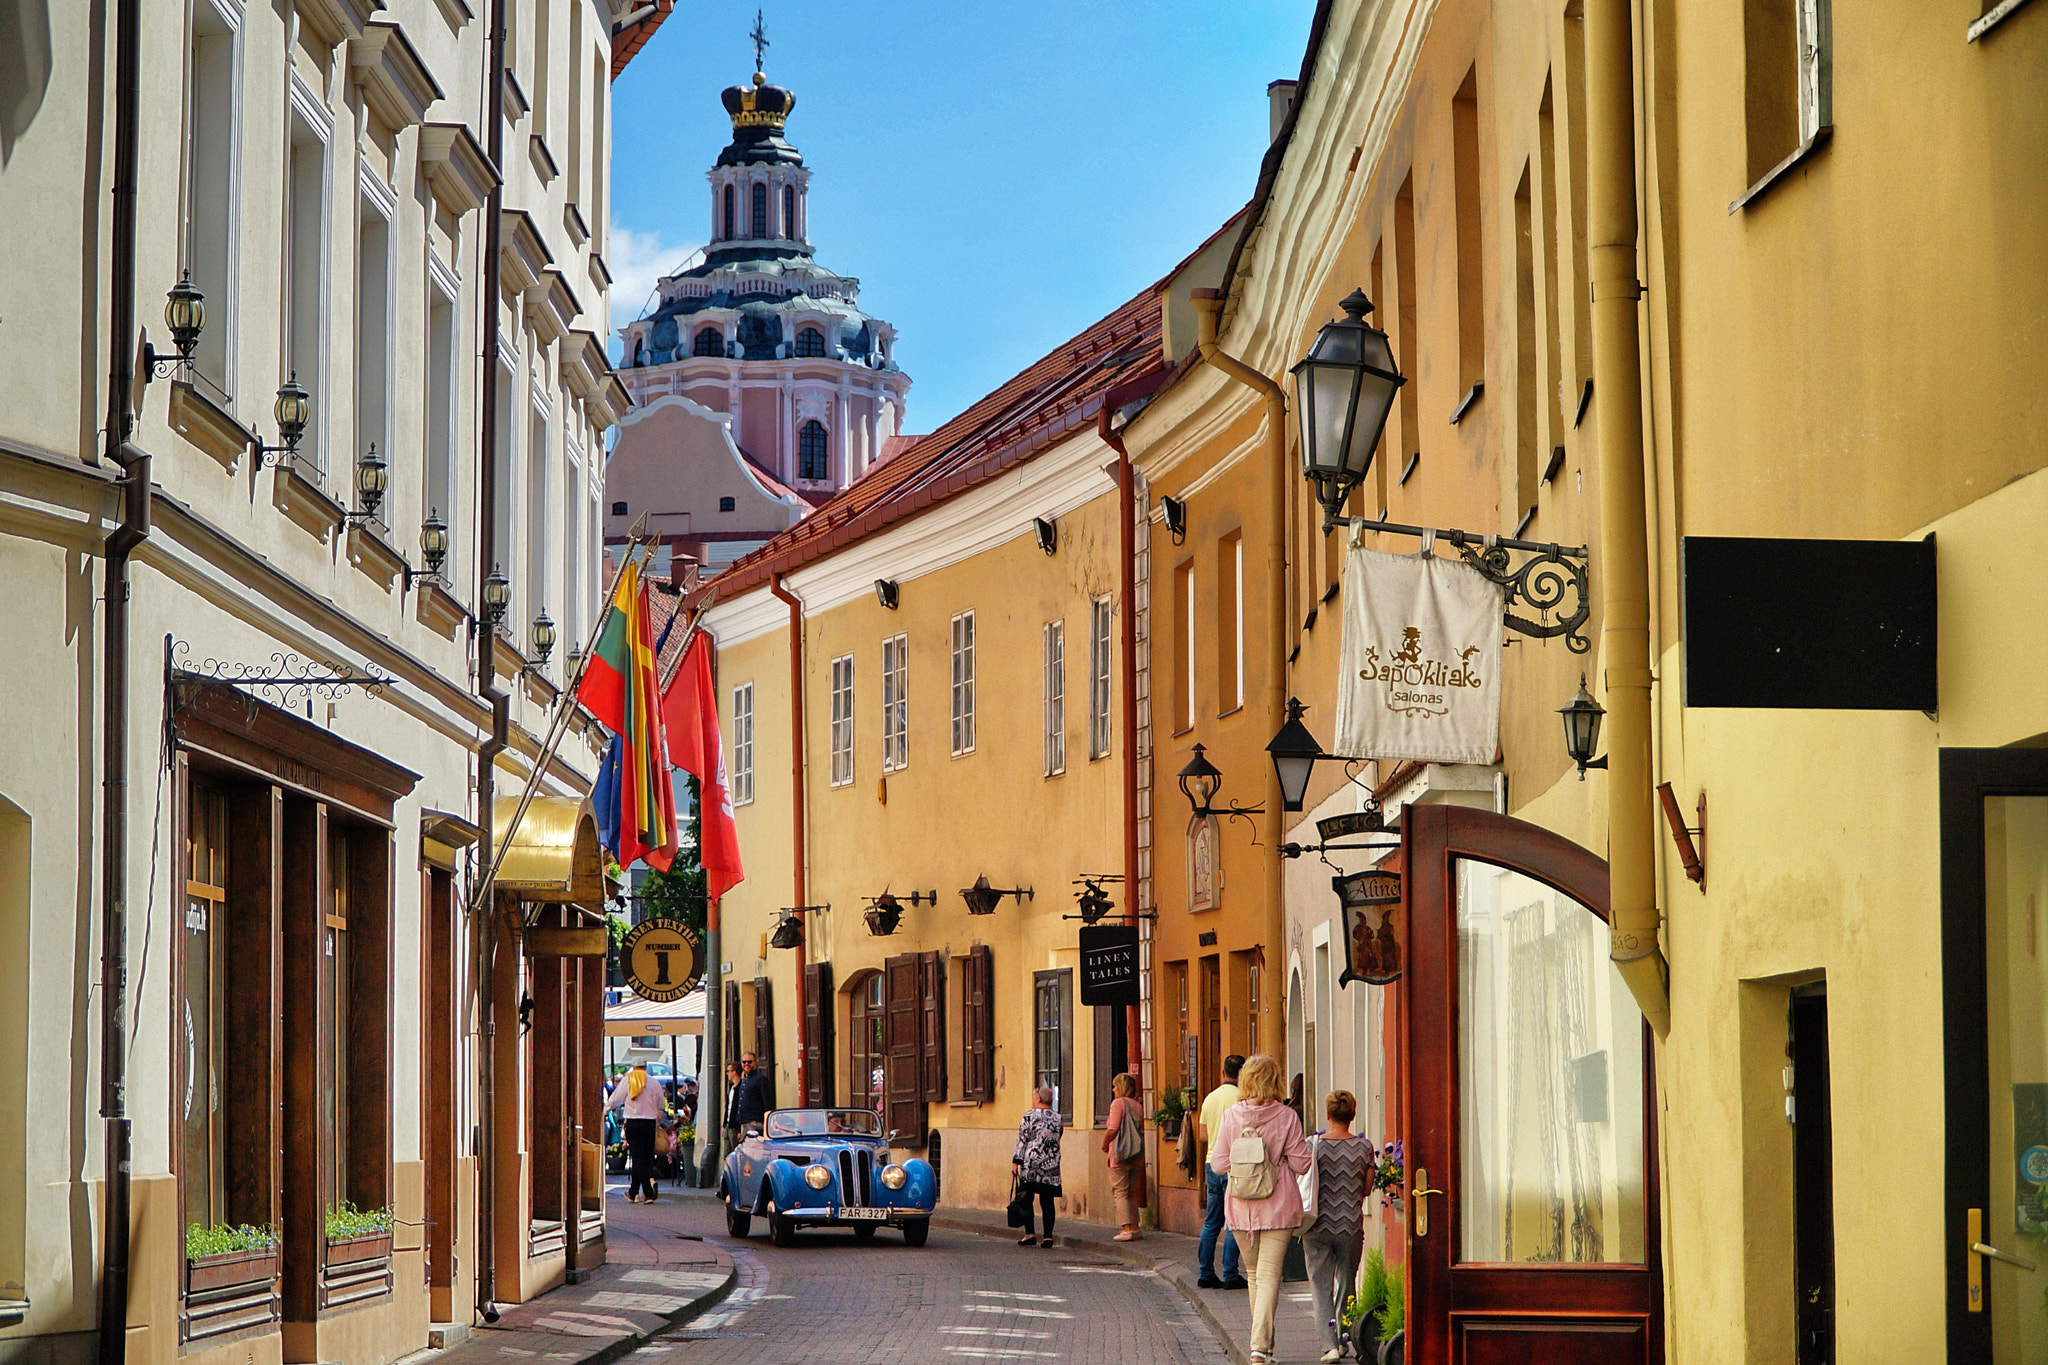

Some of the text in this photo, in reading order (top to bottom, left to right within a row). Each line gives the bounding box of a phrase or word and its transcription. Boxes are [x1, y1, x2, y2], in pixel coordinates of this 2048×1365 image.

[1393, 690, 1443, 704] salonas
[625, 918, 700, 948] LINEN TEXTILE
[645, 943, 681, 951] NUMBER
[1089, 952, 1130, 966] LINEN
[654, 952, 672, 985] 1
[1089, 966, 1131, 980] TALES
[640, 976, 698, 1002] LITHUANIA
[840, 1208, 886, 1218] FAR 327
